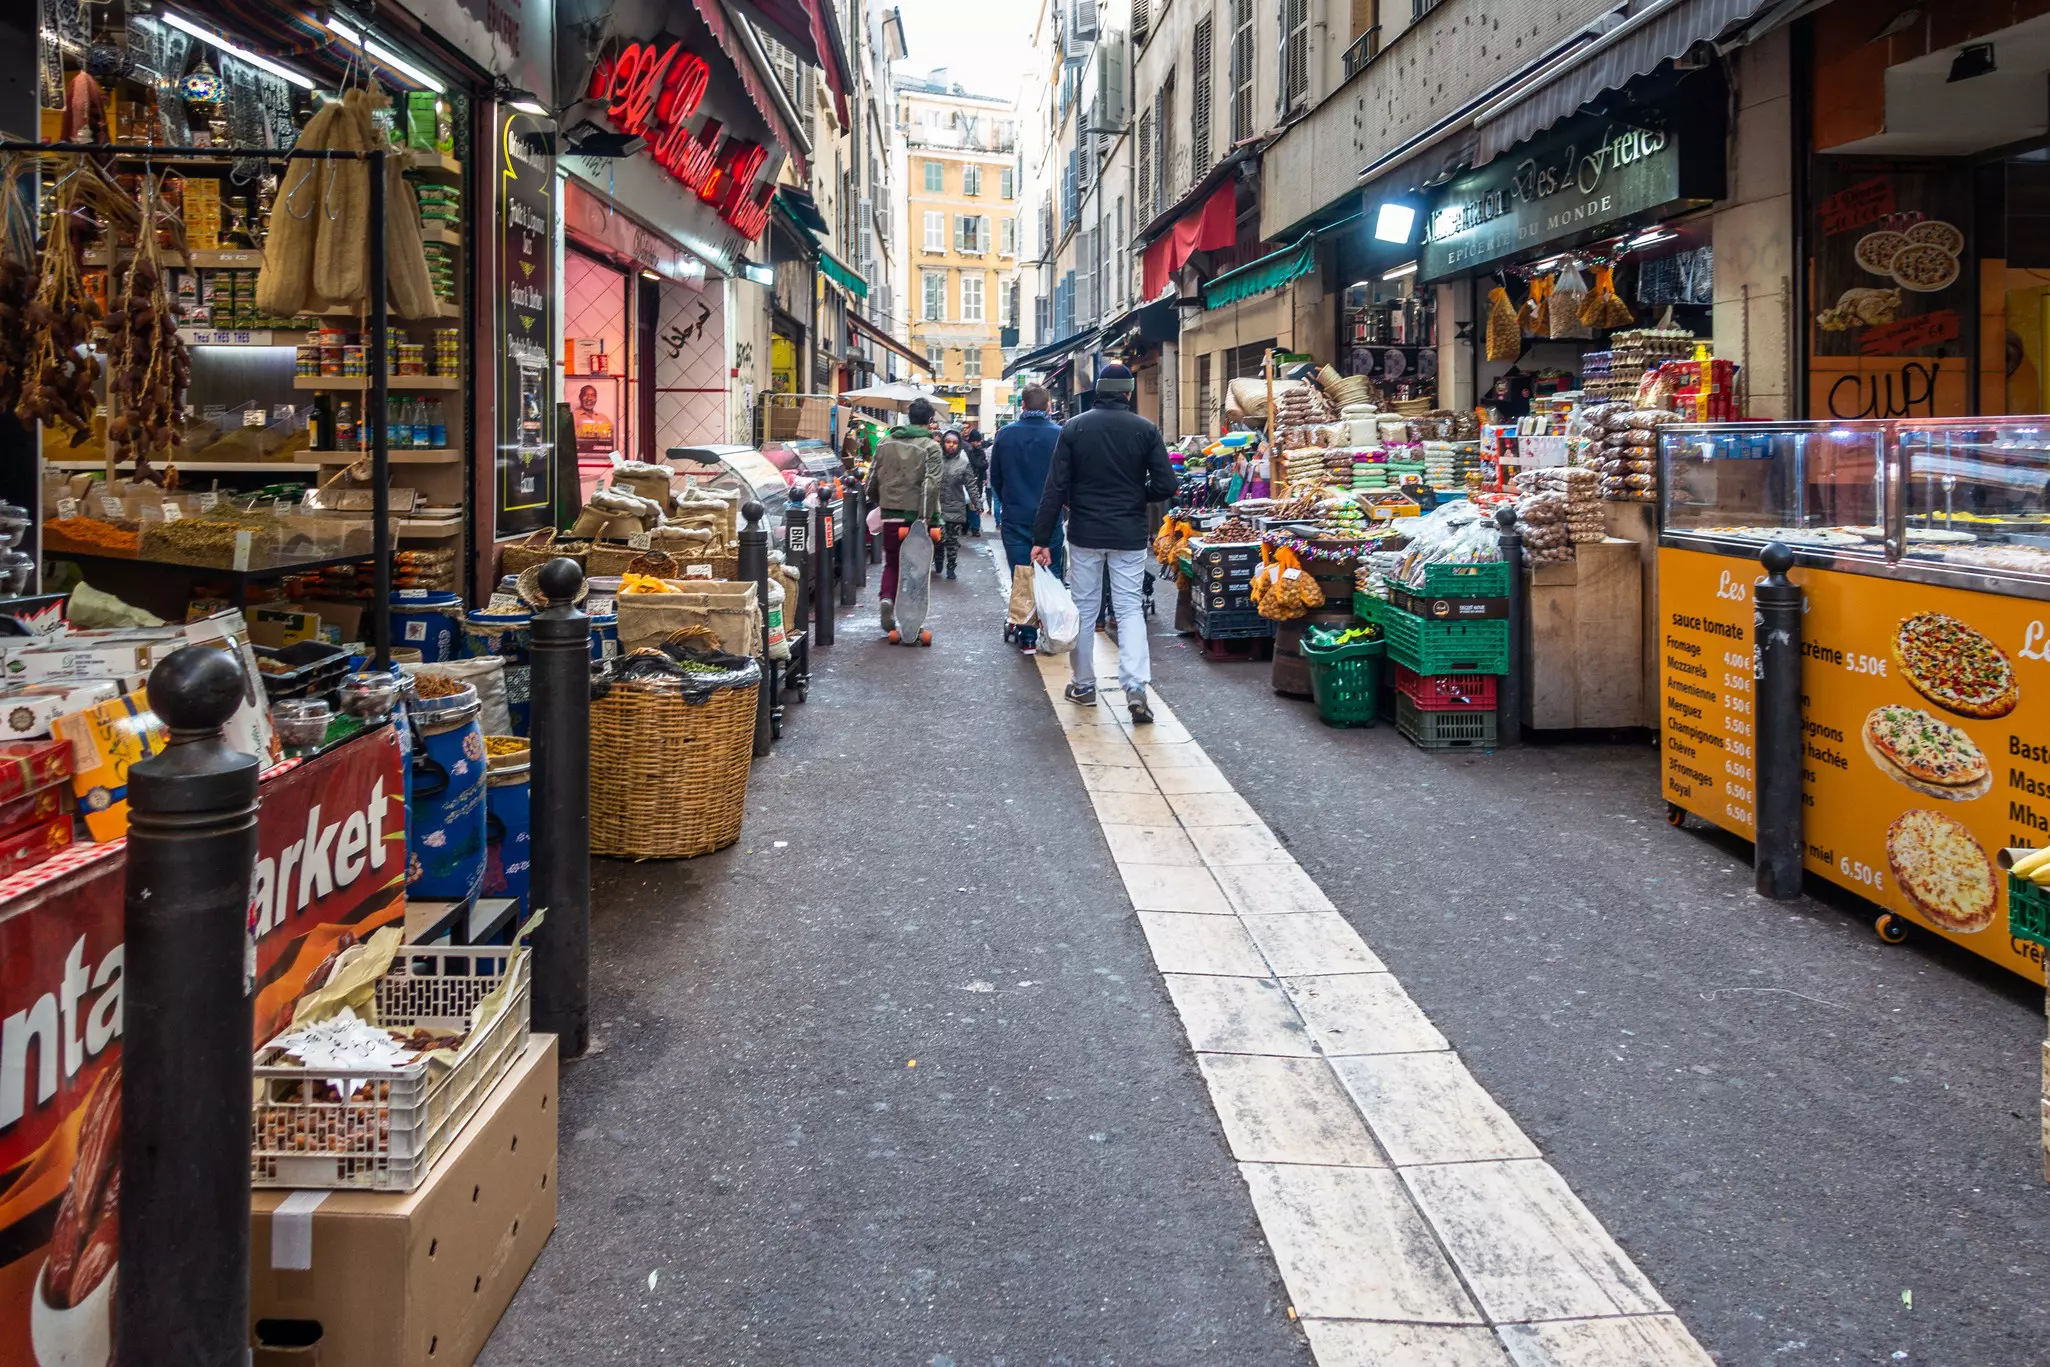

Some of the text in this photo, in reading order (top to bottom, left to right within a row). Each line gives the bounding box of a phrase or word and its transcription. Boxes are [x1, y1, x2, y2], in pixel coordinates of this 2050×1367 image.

[1421, 189, 1503, 246] Alintation
[1561, 145, 1576, 189] 2
[1519, 222, 1539, 240] DU
[1547, 195, 1612, 230] MONDE
[790, 527, 805, 551] BNE
[1717, 569, 1746, 601] Les
[1672, 613, 1744, 640] sauce tomate
[1666, 635, 1701, 657] Fromage
[1846, 653, 1887, 678] 5.50€
[1668, 696, 1702, 719] Merguez
[1668, 717, 1724, 748] Champignons
[1808, 742, 1848, 770] hachée
[1669, 777, 1691, 797] Royal
[255, 774, 388, 941] arket
[1809, 844, 1834, 865] miel
